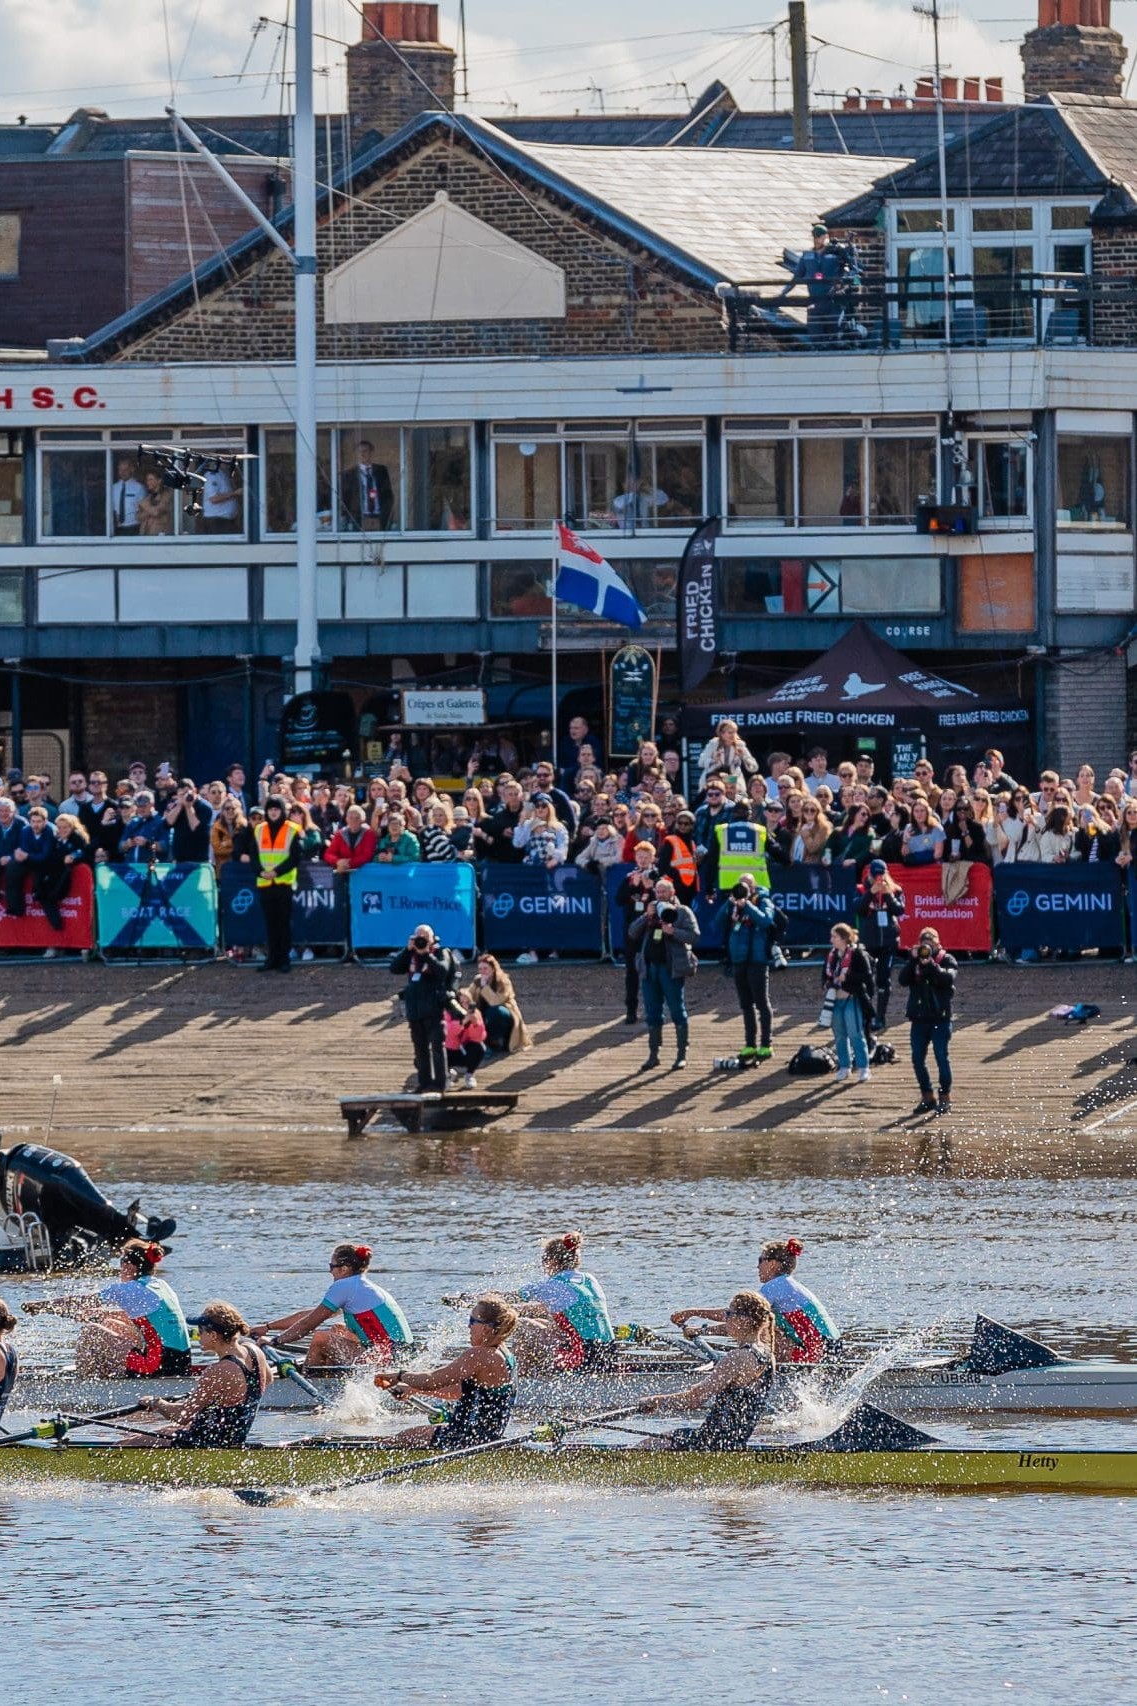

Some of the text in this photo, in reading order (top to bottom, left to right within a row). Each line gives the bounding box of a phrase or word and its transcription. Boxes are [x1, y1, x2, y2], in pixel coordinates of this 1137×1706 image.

[31, 386, 63, 409] S.
[73, 386, 106, 409] C.
[686, 581, 700, 640] FRIED
[699, 563, 716, 651] CHICKEN
[782, 675, 823, 689] FREE
[898, 671, 927, 683] FREE
[766, 692, 809, 702] JANE
[774, 683, 829, 696] RANGE
[407, 698, 436, 711] Crêpes
[445, 698, 481, 709] Galettes
[711, 711, 895, 726] FREE RANGE FRIED CHICKEN
[938, 709, 1030, 727] FREE RANGE FRIED CHICKEN
[729, 842, 754, 851] WISE
[292, 890, 335, 909] MINI
[519, 896, 593, 914] GEMINI
[771, 893, 847, 912] GEMINI
[1035, 893, 1112, 912] GEMINI
[159, 906, 192, 917] RACE
[914, 908, 974, 919] Foundation
[1018, 1454, 1060, 1470] Hetty
